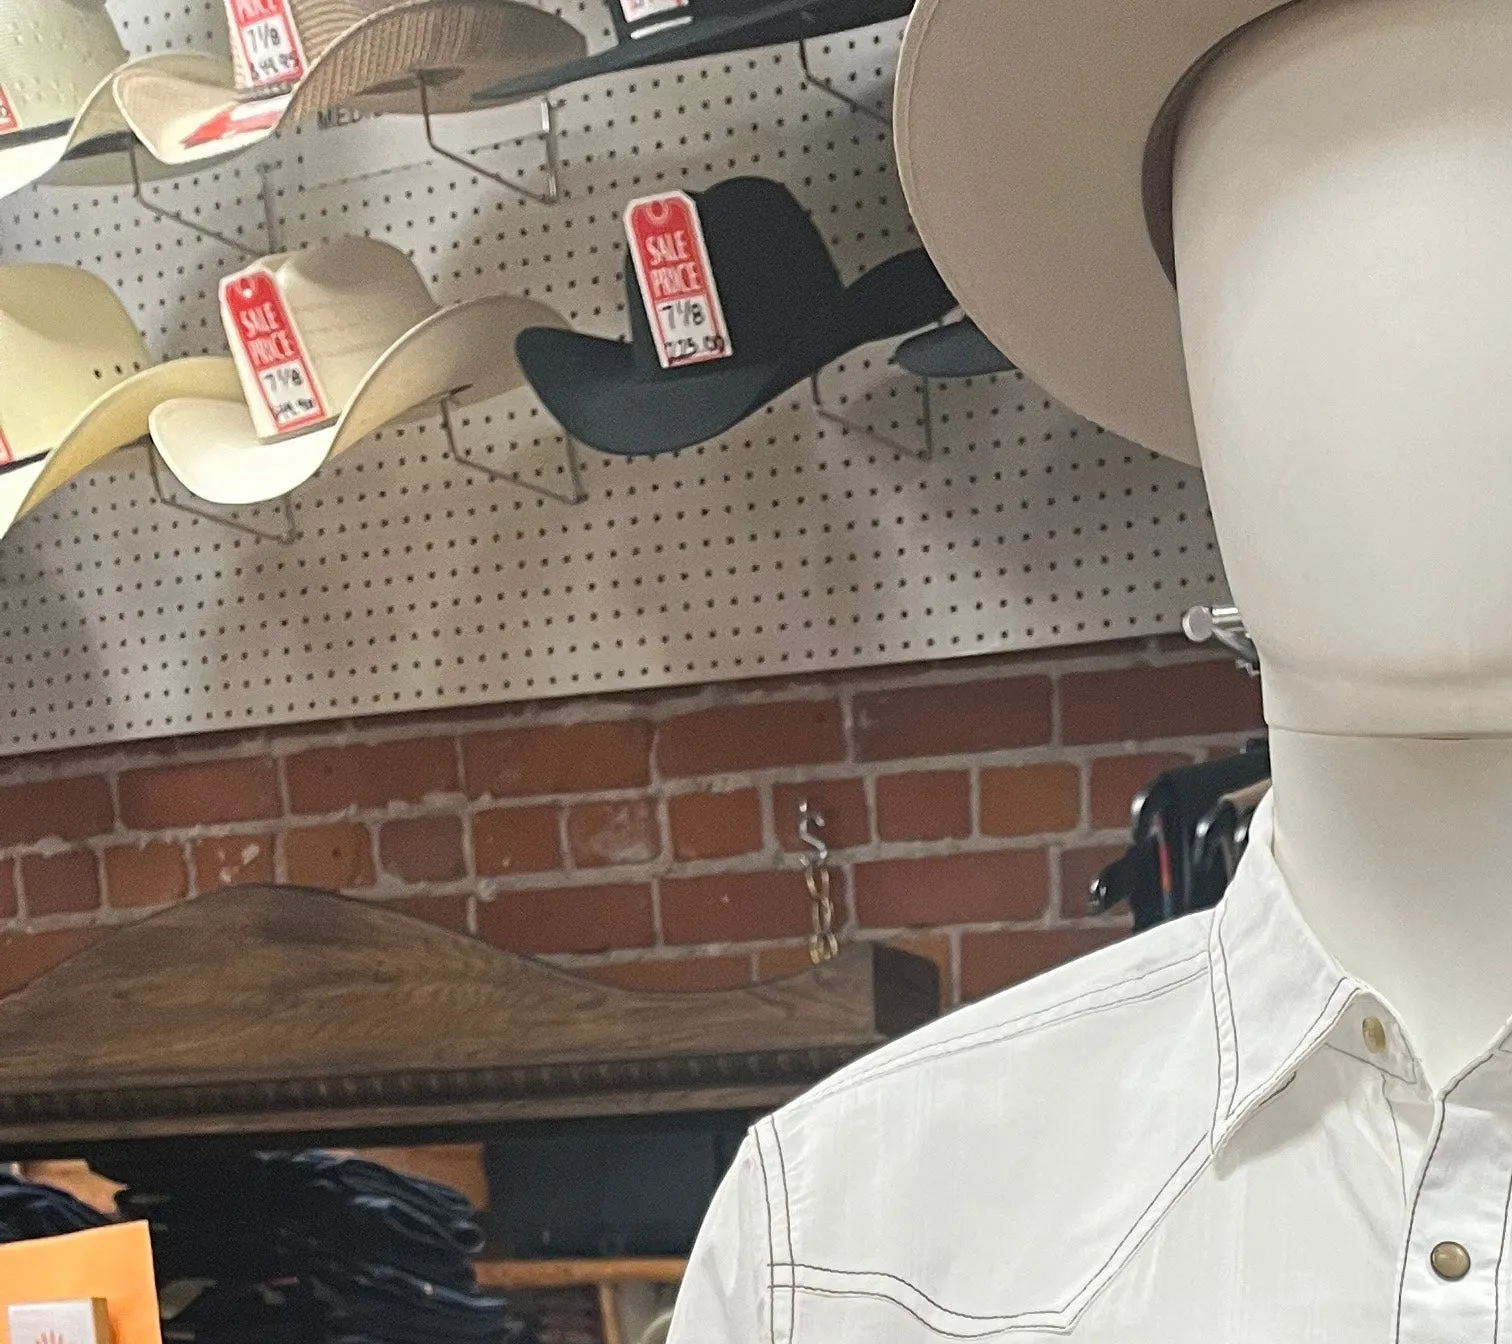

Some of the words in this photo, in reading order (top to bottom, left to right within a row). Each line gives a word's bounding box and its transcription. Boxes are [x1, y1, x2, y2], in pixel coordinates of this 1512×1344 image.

[644, 230, 689, 265] SALE
[651, 261, 704, 297] PRICE
[239, 301, 280, 340] SALE
[248, 330, 296, 365] PRICE
